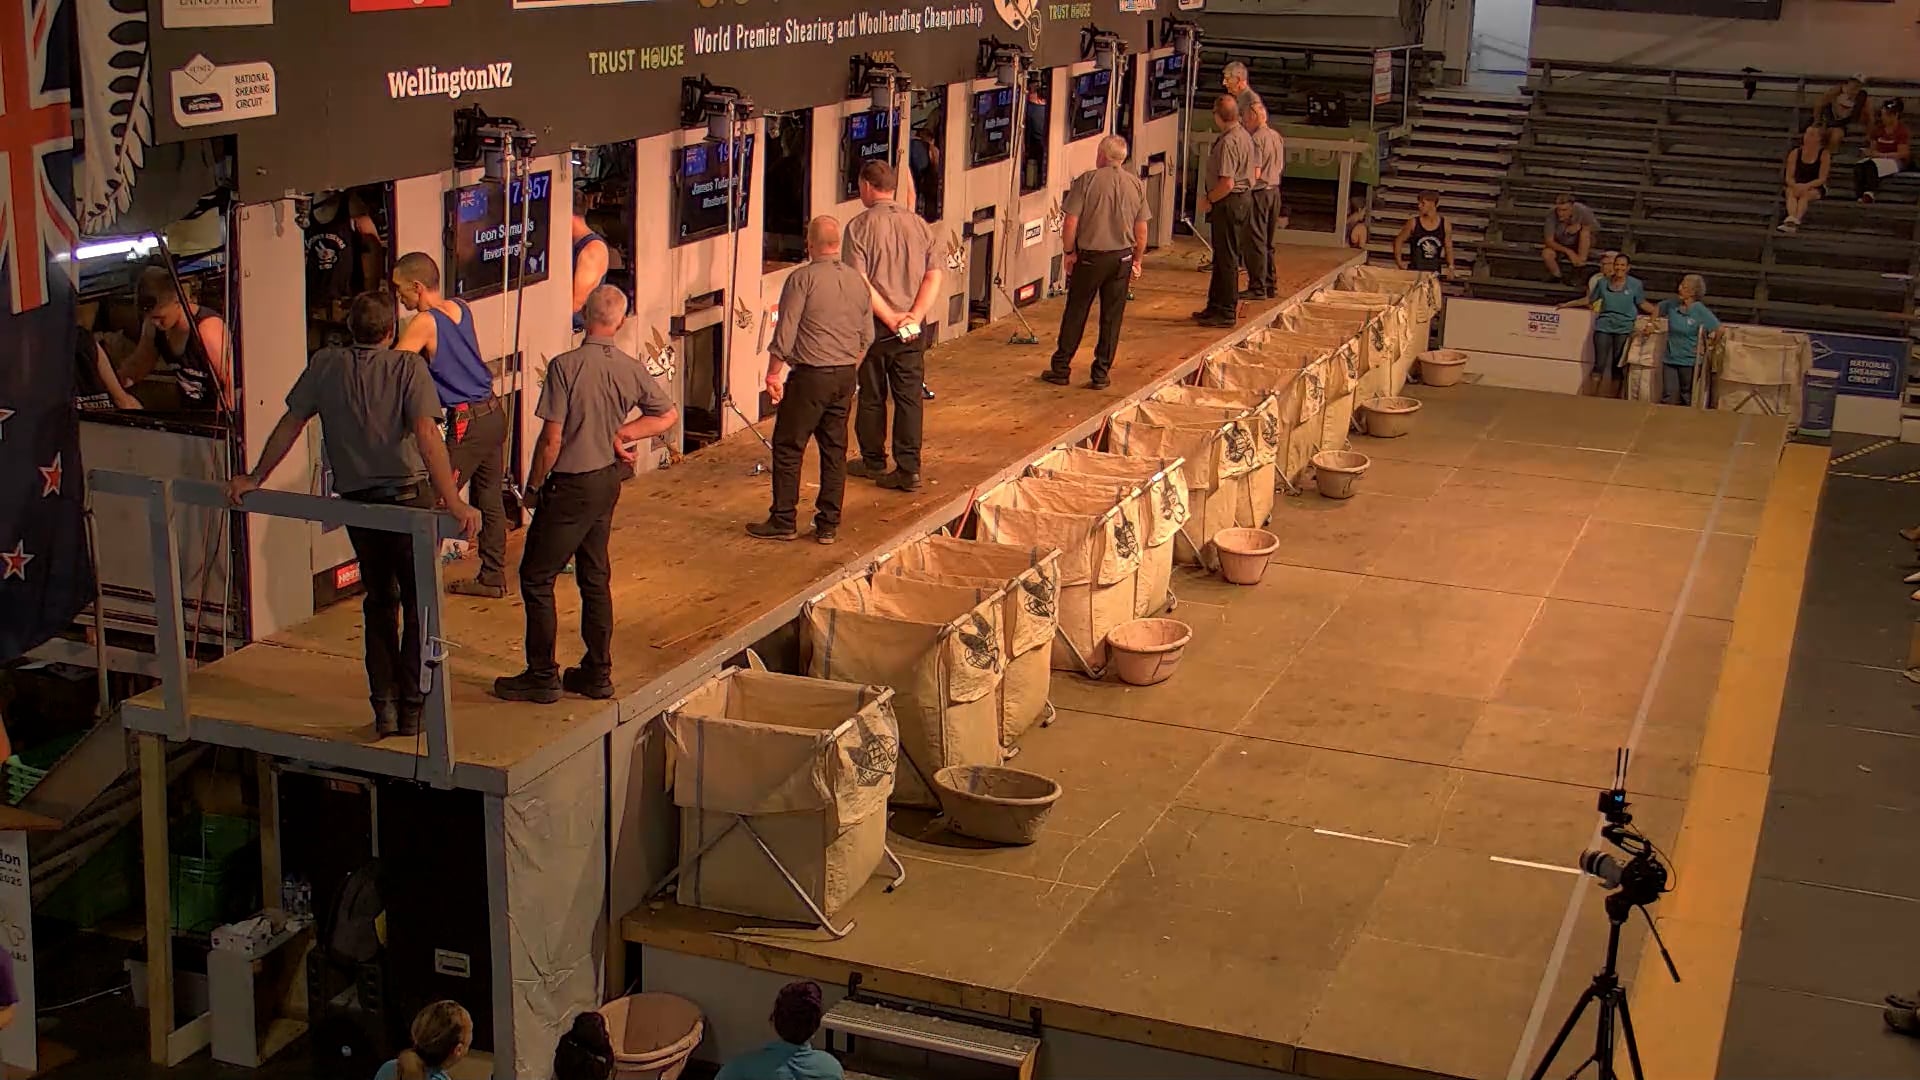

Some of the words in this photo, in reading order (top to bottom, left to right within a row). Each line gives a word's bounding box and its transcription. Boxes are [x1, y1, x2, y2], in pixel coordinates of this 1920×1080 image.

[1049, 3, 1070, 20] TRUST
[694, 25, 730, 55] World
[736, 22, 781, 49] Premier
[785, 17, 834, 44] Shearing
[837, 12, 855, 39] and
[858, 9, 922, 36] Woolhandling
[924, 2, 983, 31] Championship
[589, 49, 636, 75] TRUST
[640, 44, 685, 70] HOUSE
[234, 72, 270, 85] NATIONAL
[387, 62, 513, 99] WellingtonNZ
[235, 83, 270, 98] SHEARING
[235, 97, 263, 110] CIRCUIT
[691, 181, 714, 195] James
[475, 229, 497, 244] Leon
[498, 218, 534, 238] Smuls
[681, 224, 688, 237] 2
[538, 250, 546, 273] 1
[458, 279, 463, 294] 1
[1849, 360, 1890, 369] NATIONAL
